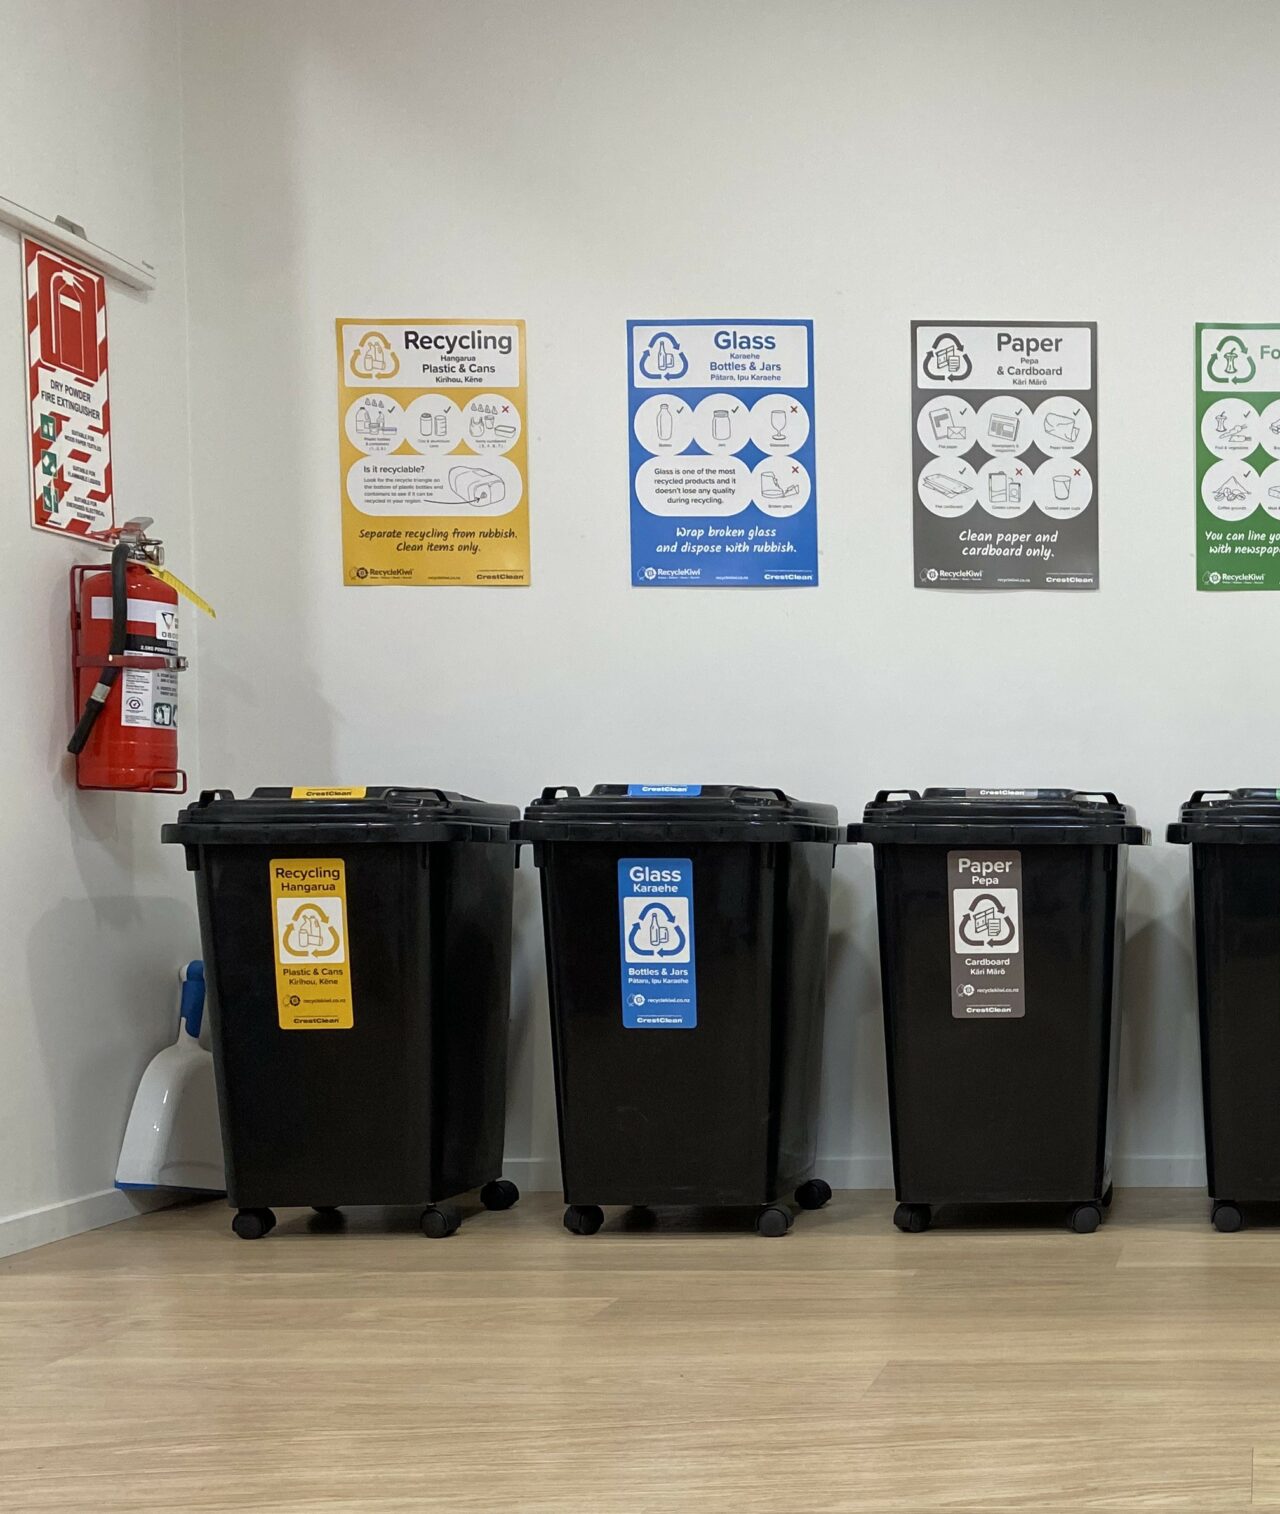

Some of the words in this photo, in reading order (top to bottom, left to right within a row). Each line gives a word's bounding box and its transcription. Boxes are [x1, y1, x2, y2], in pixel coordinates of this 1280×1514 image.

[404, 330, 512, 355] Recycling
[714, 330, 776, 350] Glass
[997, 332, 1063, 357] Paper
[440, 355, 476, 363] Hangarua
[710, 361, 747, 371] Bottles
[748, 361, 757, 371] &
[759, 362, 782, 371] Jars
[1020, 355, 1039, 365] Pepa
[422, 364, 456, 373] Plastic
[458, 364, 466, 373] &
[468, 363, 496, 373] Cans
[996, 366, 1005, 376] &
[1007, 366, 1063, 376] Cardboard
[50, 379, 64, 393] DRY
[65, 385, 91, 403] POWDER
[41, 391, 56, 404] FIRE
[57, 396, 100, 420] EXTINGUISHER
[379, 465, 425, 475] recyclable?
[358, 529, 402, 541] Separate
[404, 528, 449, 542] recycling
[452, 528, 476, 538] from
[478, 528, 518, 538] rubbish.
[676, 527, 705, 540] Wrap
[708, 525, 745, 537] broken
[747, 526, 777, 540] glass
[958, 529, 993, 542] Clean
[995, 533, 1032, 547] paper
[1035, 530, 1059, 542] and
[1205, 531, 1223, 541] You
[1226, 533, 1245, 545] can
[1247, 530, 1267, 541] line
[396, 541, 424, 552] Clean
[426, 542, 455, 552] items
[457, 541, 481, 555] only.
[656, 541, 678, 552] and
[680, 541, 722, 556] dispose
[725, 541, 750, 553] with
[753, 541, 797, 553] rubbish.
[962, 543, 1023, 556] cardboard
[1025, 544, 1055, 561] only.
[1209, 542, 1232, 554] with
[275, 866, 340, 881] Recycling
[629, 866, 682, 882] Glass
[958, 858, 1012, 876] Paper
[971, 875, 999, 886] Pepa
[281, 882, 336, 894] Hangarua
[633, 883, 679, 893] Karaehe
[321, 968, 344, 976] Cans
[628, 967, 660, 976] Bottles
